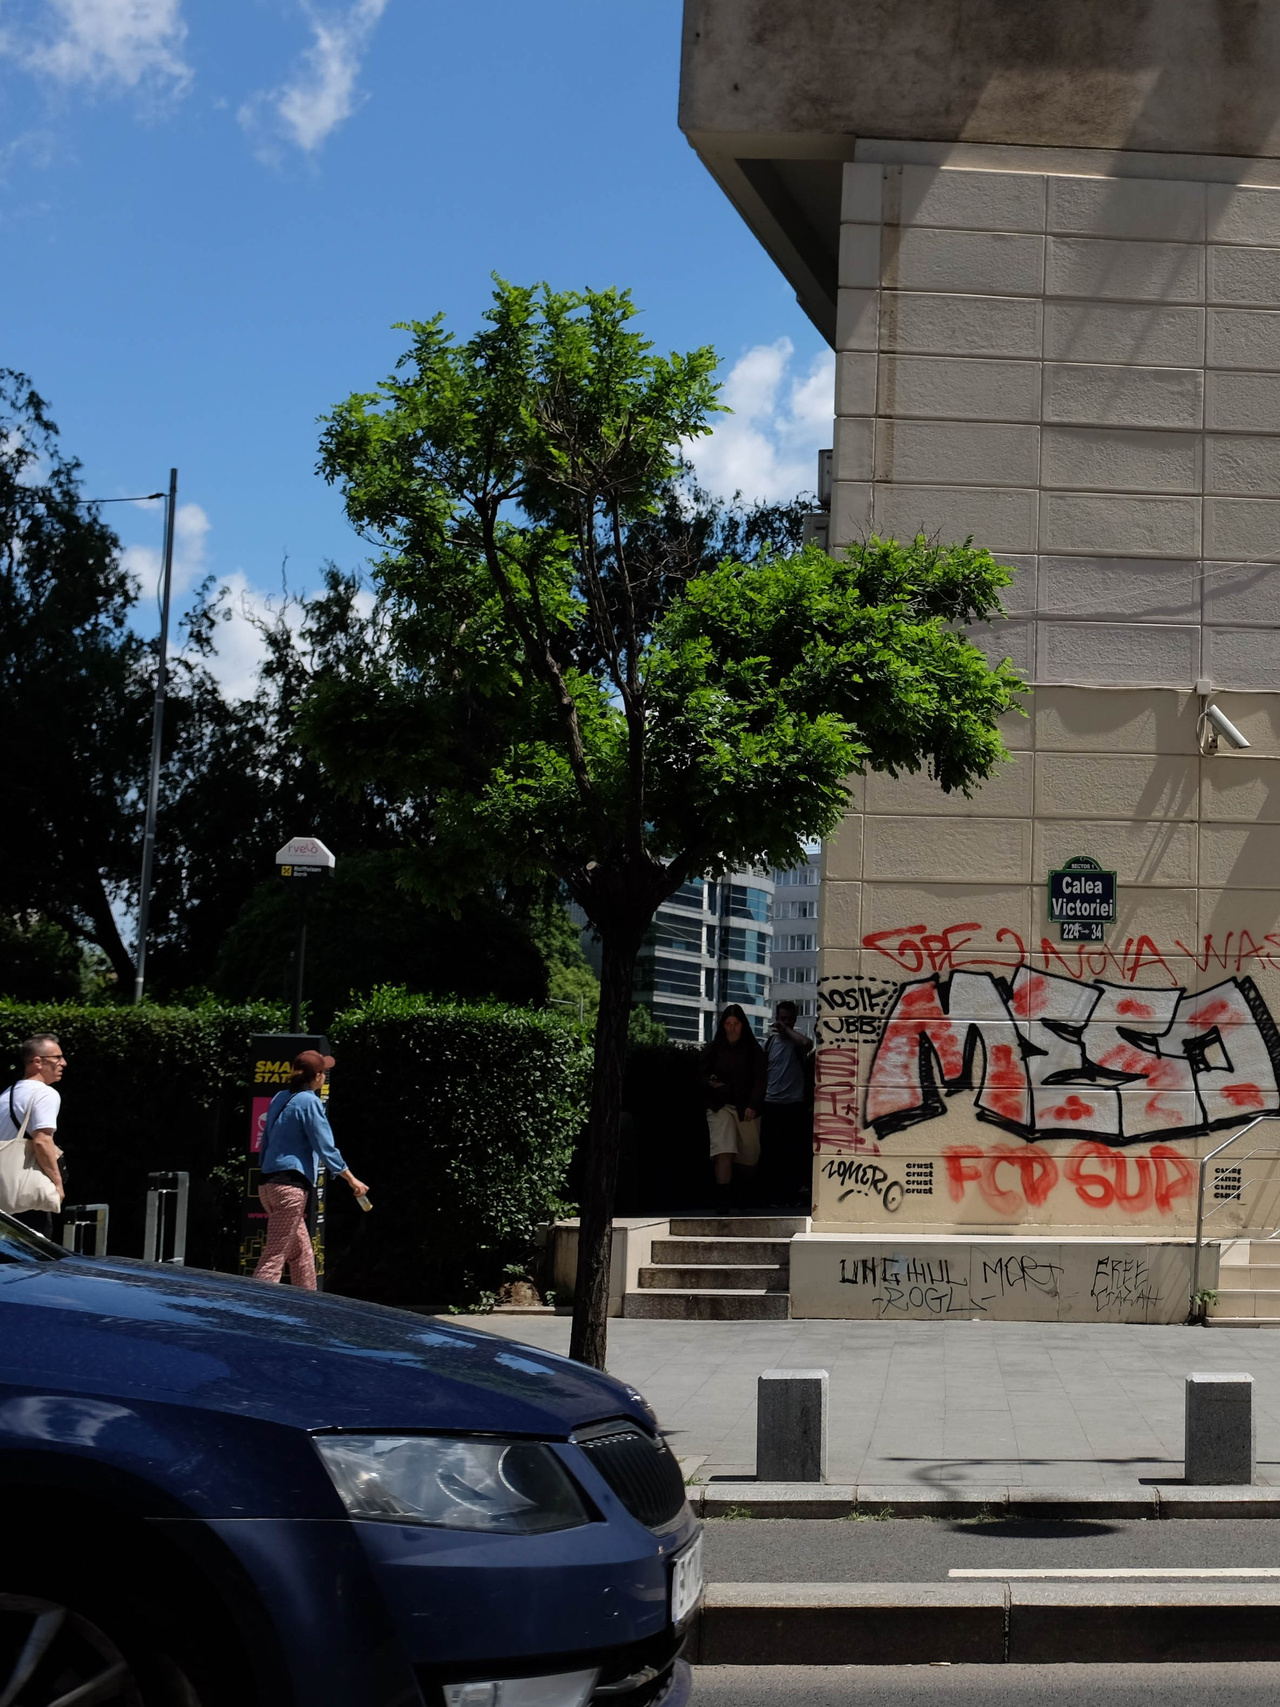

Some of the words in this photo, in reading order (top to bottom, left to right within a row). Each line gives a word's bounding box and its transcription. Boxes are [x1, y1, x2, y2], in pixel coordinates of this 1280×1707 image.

[1062, 876, 1103, 895] Calea
[1051, 897, 1114, 917] Victoriei
[1090, 922, 1102, 940] 34
[254, 1060, 291, 1072] SMA
[253, 1073, 288, 1083] STAT
[905, 1162, 934, 1170] crust
[905, 1170, 934, 1178] crust
[905, 1179, 934, 1187] crust
[905, 1187, 934, 1195] crust
